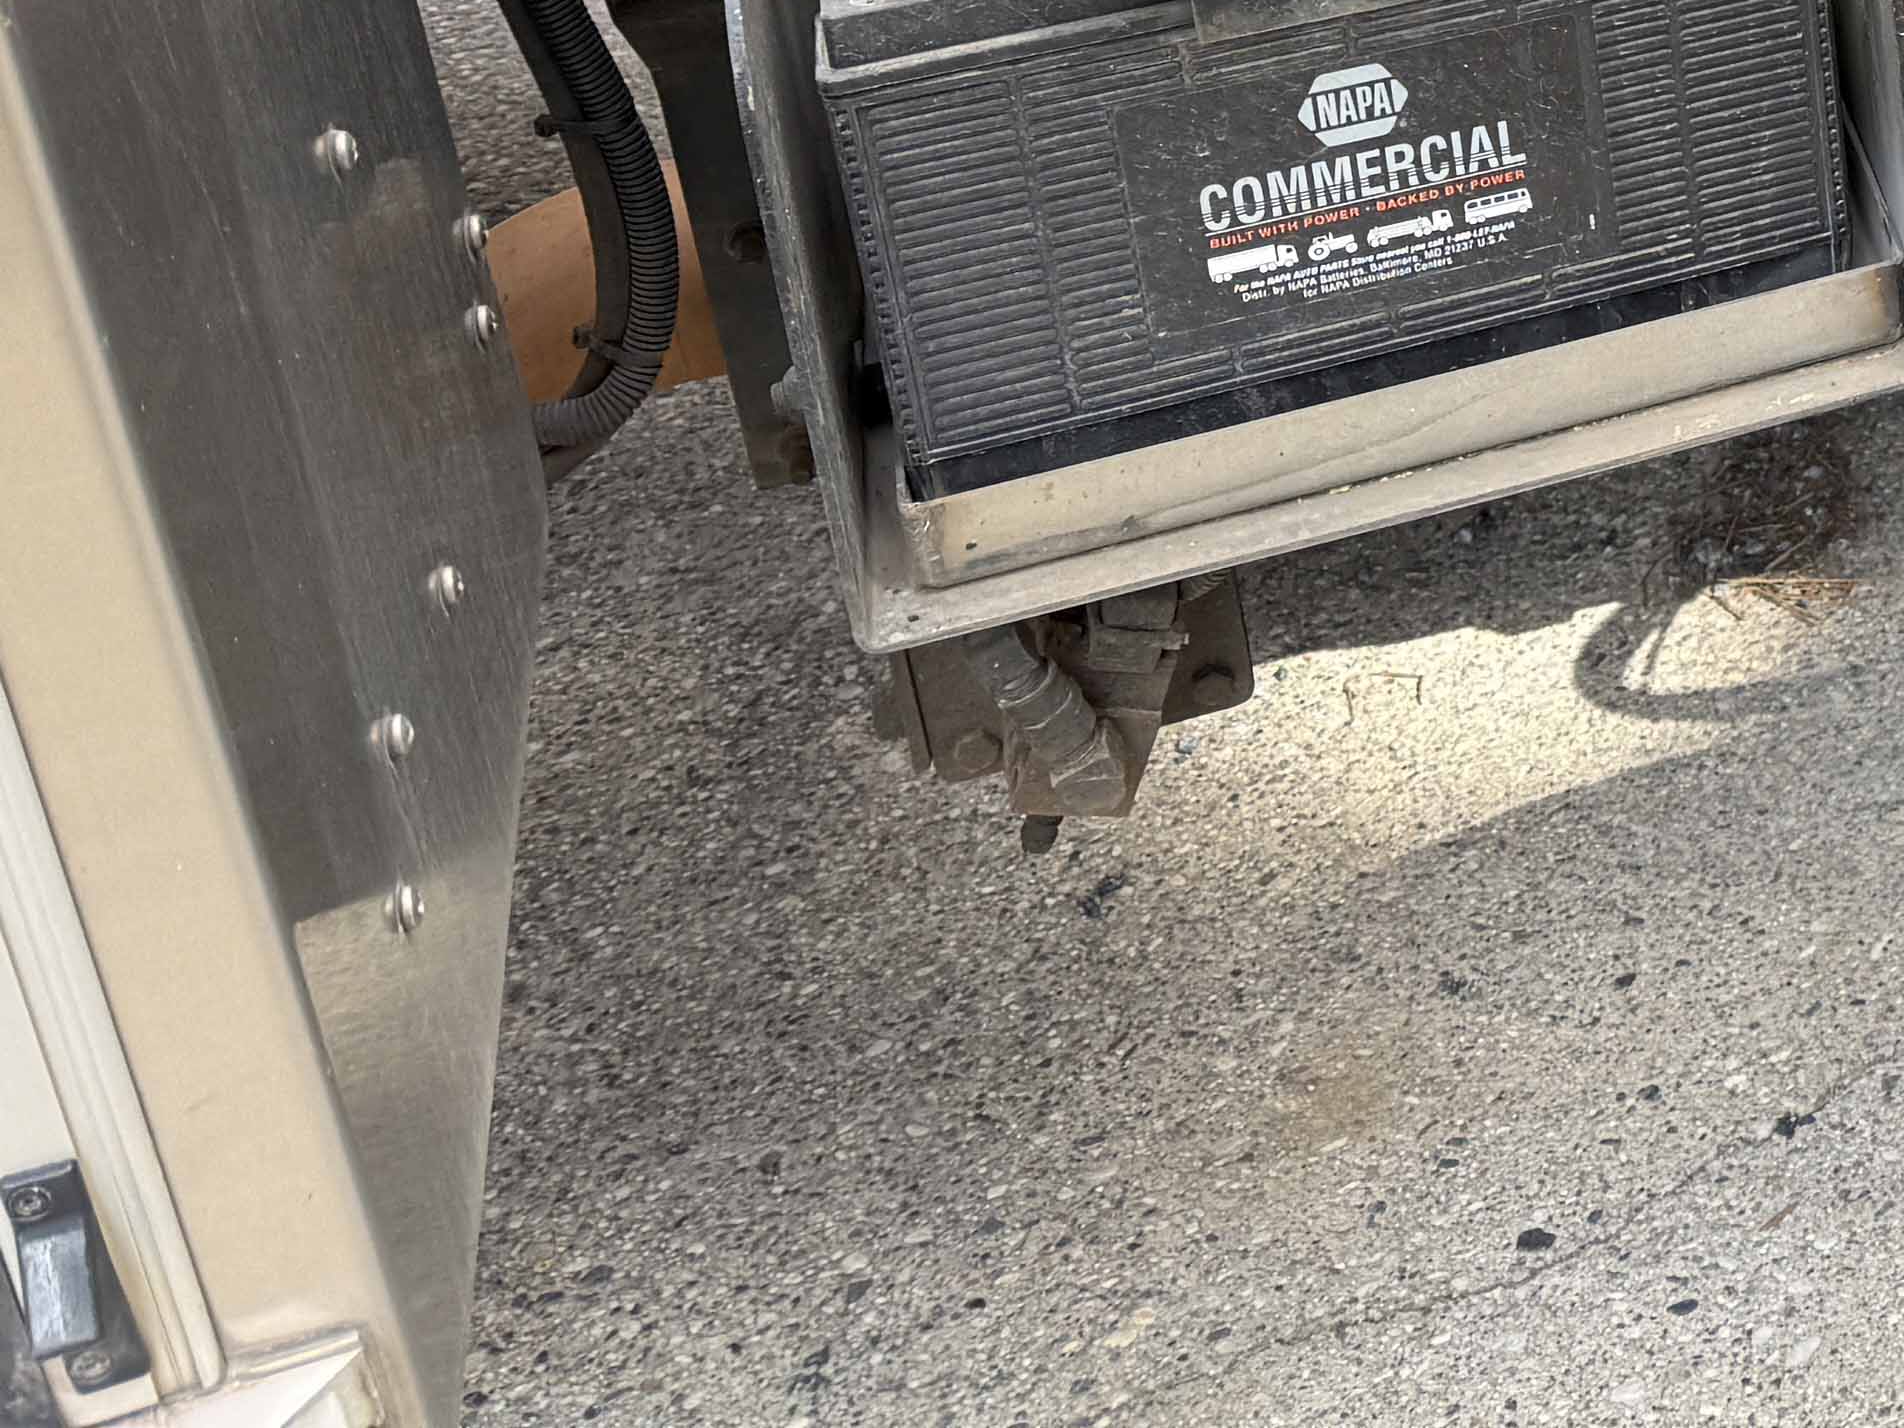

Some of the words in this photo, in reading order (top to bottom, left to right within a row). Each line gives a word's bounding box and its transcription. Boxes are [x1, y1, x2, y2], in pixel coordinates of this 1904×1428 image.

[1317, 81, 1392, 130] NAPA
[1200, 120, 1527, 232] COMMERCIAL
[1210, 230, 1255, 249] BUILT
[1258, 222, 1299, 239] WITH
[1303, 207, 1360, 228] POWER
[1376, 189, 1440, 212] BACKED
[1445, 184, 1465, 197] BY
[1470, 168, 1527, 191] POWER
[1272, 285, 1285, 297] by
[1288, 277, 1318, 292] NAPA
[1424, 247, 1442, 260] MD
[1444, 241, 1474, 256] 21237
[1320, 280, 1350, 295] NAPA
[1414, 256, 1453, 273] Centers
